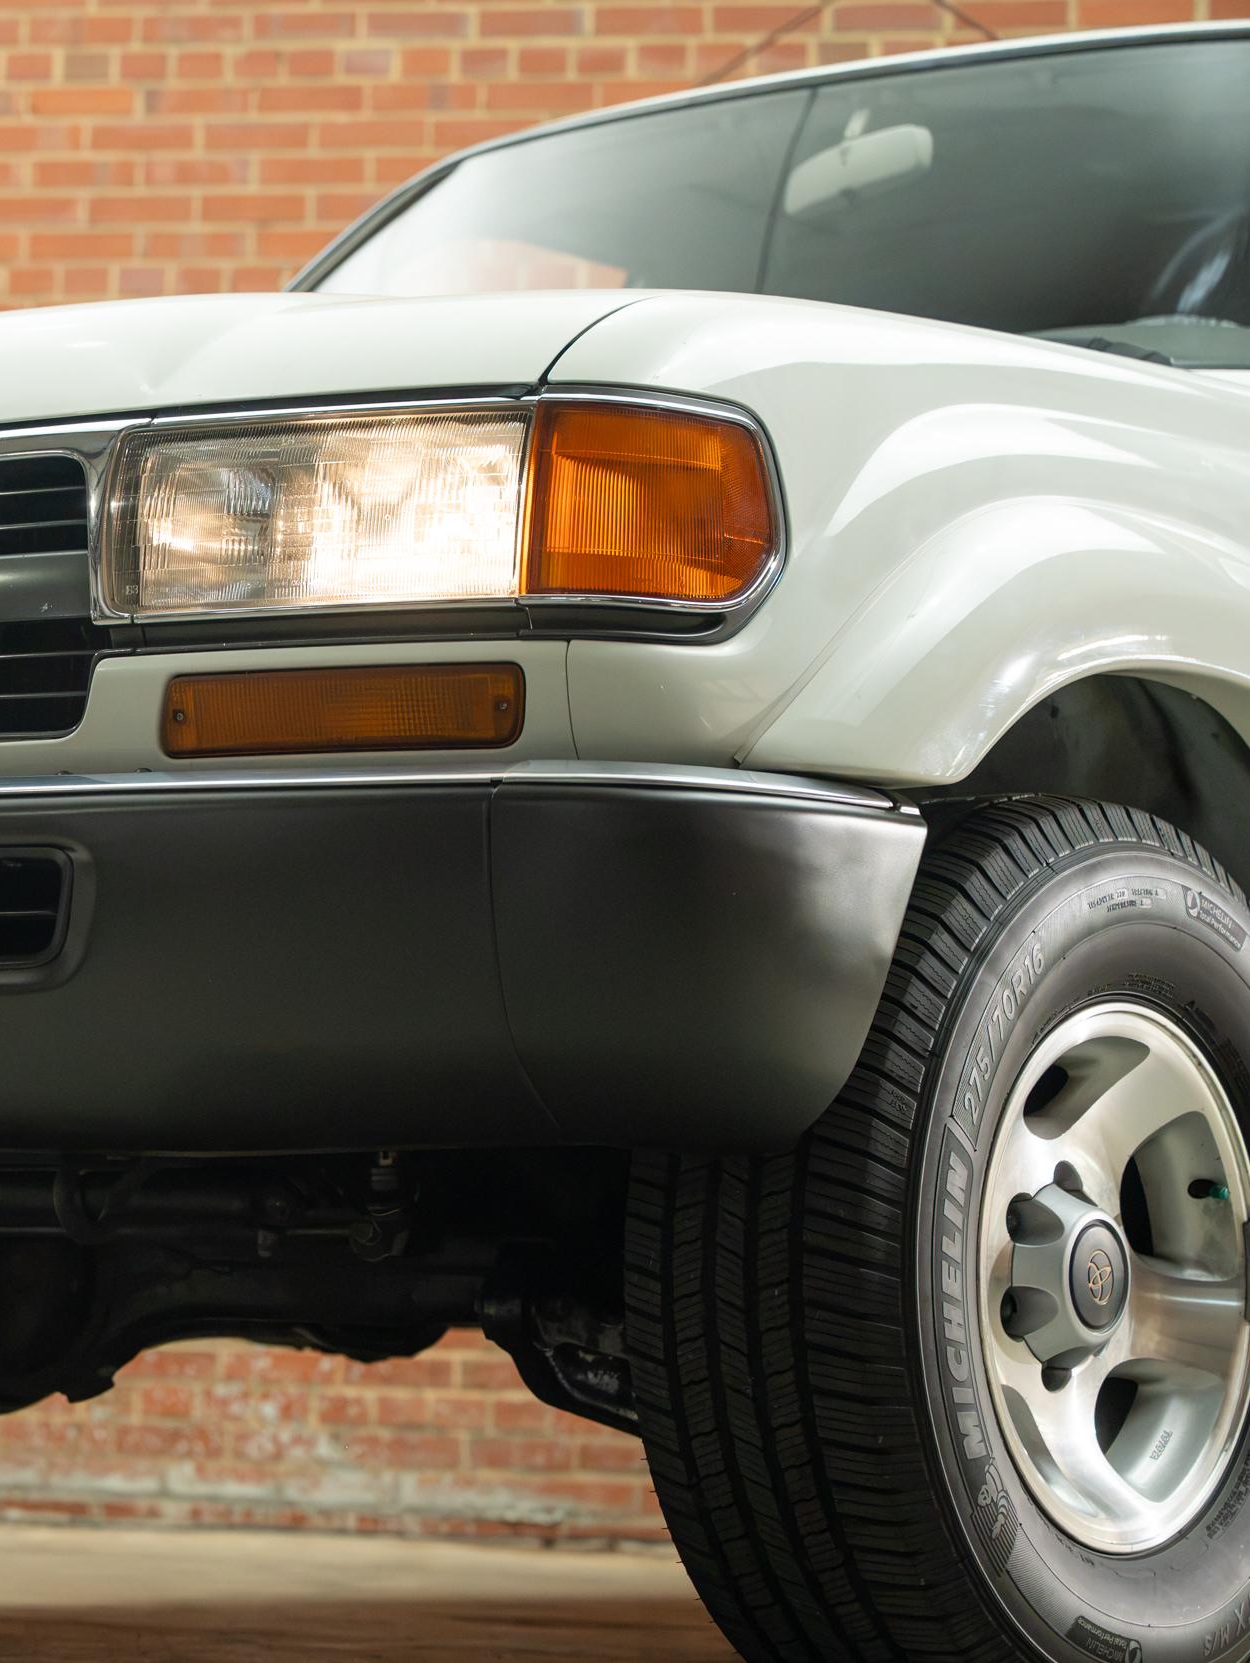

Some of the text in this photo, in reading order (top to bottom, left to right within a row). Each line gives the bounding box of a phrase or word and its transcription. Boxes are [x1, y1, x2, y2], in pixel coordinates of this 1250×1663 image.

[1201, 899, 1233, 929] MICHELIN
[963, 943, 1045, 1125] 275/70R16
[941, 1151, 989, 1461] MICHELIN
